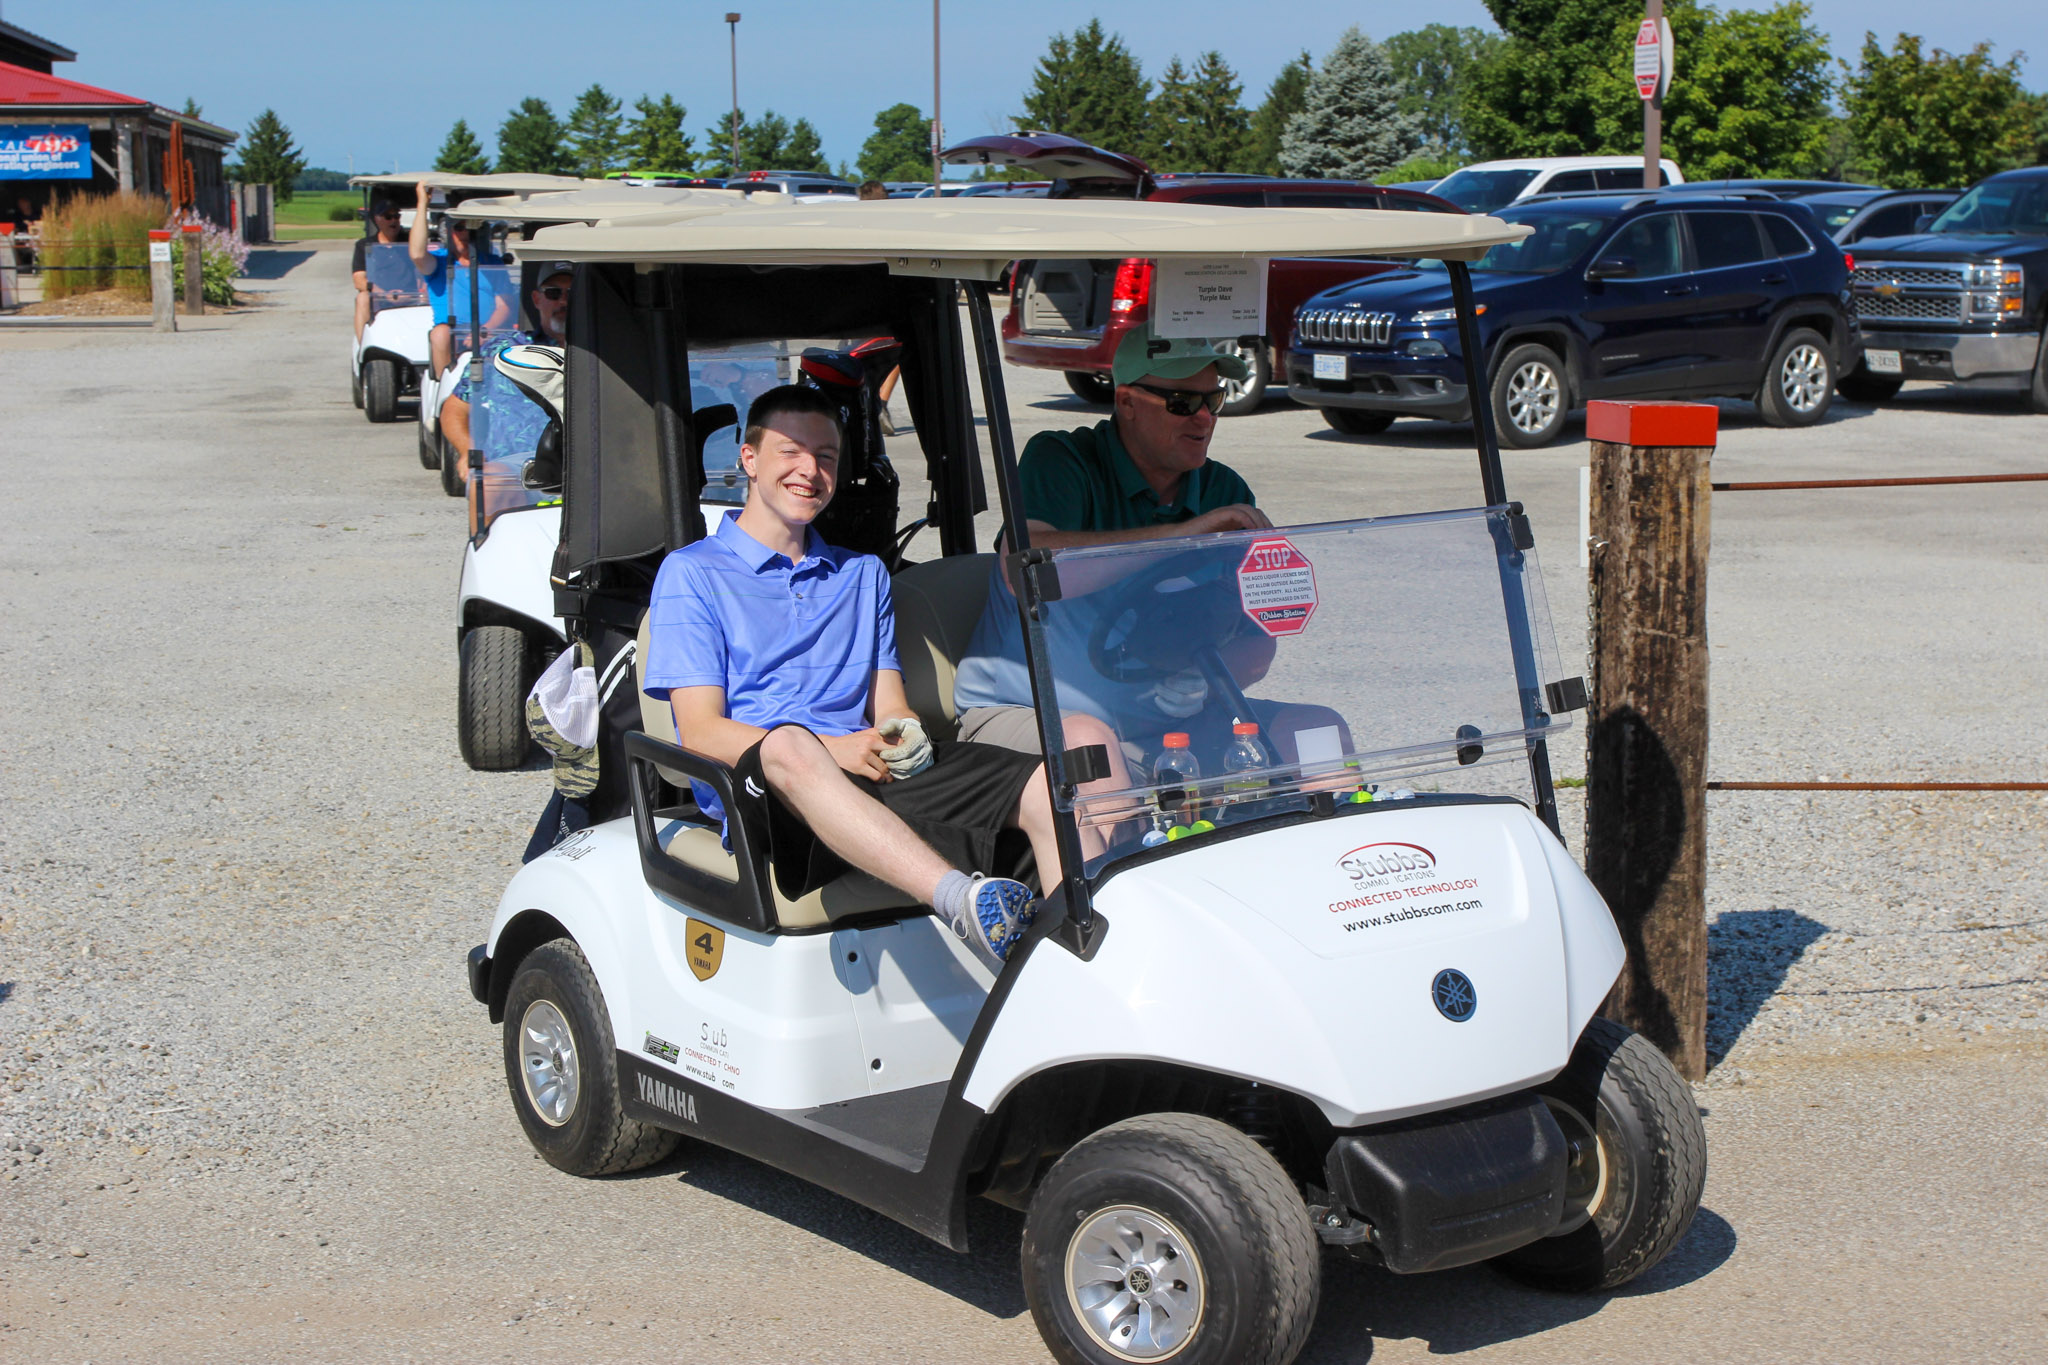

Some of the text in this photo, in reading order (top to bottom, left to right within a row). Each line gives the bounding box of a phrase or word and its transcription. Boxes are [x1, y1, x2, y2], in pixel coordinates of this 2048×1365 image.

[29, 135, 78, 153] 793
[31, 161, 80, 171] engineers
[1254, 548, 1290, 569] STOP
[1341, 852, 1429, 880] Stubbs
[1328, 878, 1479, 913] CONNECTED TECHNOLOGY
[1343, 898, 1482, 932] www.stubbscom.com
[694, 932, 714, 955] 4
[694, 956, 711, 972] YAMAHA
[685, 1048, 716, 1066] CONNECTED
[638, 1072, 698, 1124] YAMAHA
